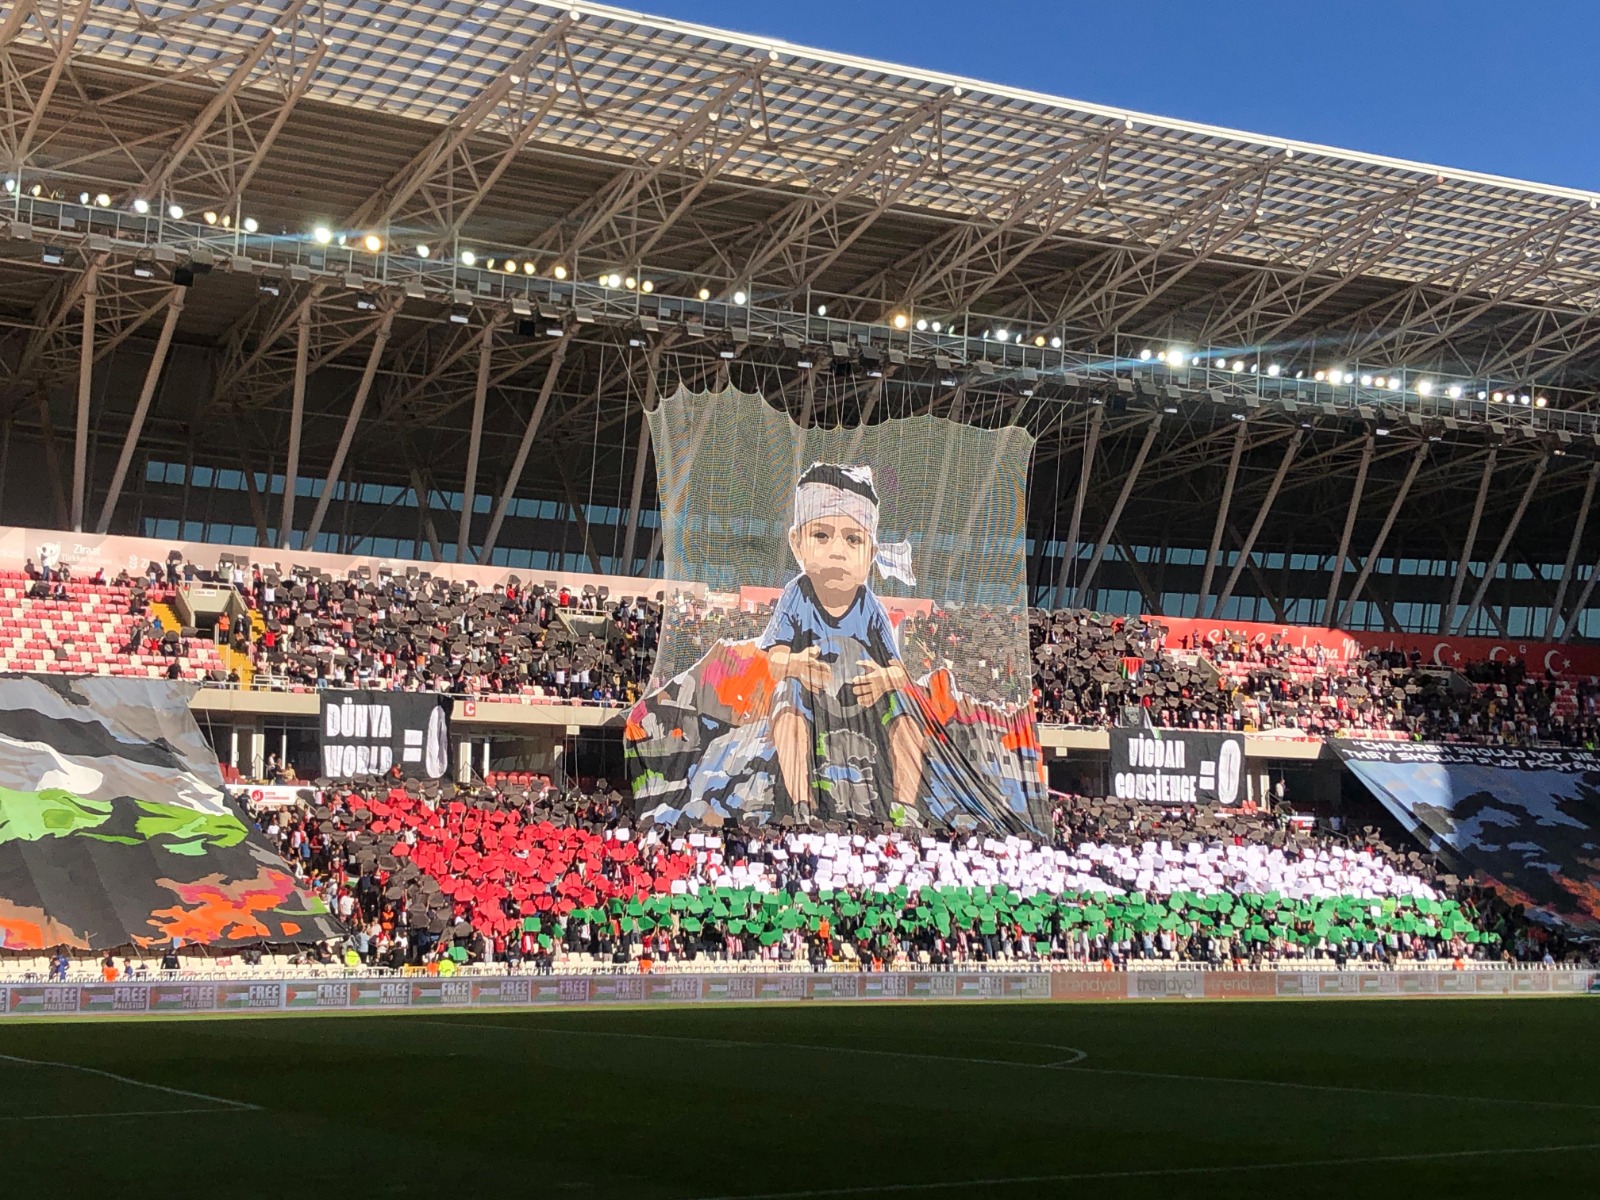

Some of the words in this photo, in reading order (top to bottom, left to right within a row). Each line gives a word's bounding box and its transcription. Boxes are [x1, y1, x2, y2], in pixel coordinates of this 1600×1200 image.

[1282, 628, 1289, 638] F
[1518, 645, 1527, 654] G
[464, 702, 475, 714] C
[326, 697, 392, 738] DÜNYA
[1128, 732, 1186, 769] VİCDAN
[1342, 748, 1391, 761] THEY
[1396, 752, 1474, 763] SHOULD
[1453, 746, 1526, 757] SHOULD
[1528, 749, 1562, 761] NOT
[324, 745, 393, 778] WORLD
[441, 982, 469, 996] FREE
[501, 981, 528, 994] FREE
[560, 980, 586, 993] FREE
[616, 979, 642, 993] FREE
[671, 979, 697, 992] FREE
[727, 978, 753, 991] FREE
[780, 977, 805, 990] FREE
[832, 976, 856, 989] FREE
[882, 976, 905, 989] FREE
[930, 976, 954, 988] FREE
[1058, 977, 1121, 994] trendyol
[1136, 975, 1197, 993] trendyol
[1209, 976, 1271, 992] trendyol
[44, 988, 77, 1002] FREE
[114, 987, 147, 1002] FREE
[183, 986, 213, 1000] FREE
[250, 985, 280, 999] FREE
[317, 984, 347, 998] FREE
[380, 983, 409, 997] FREE
